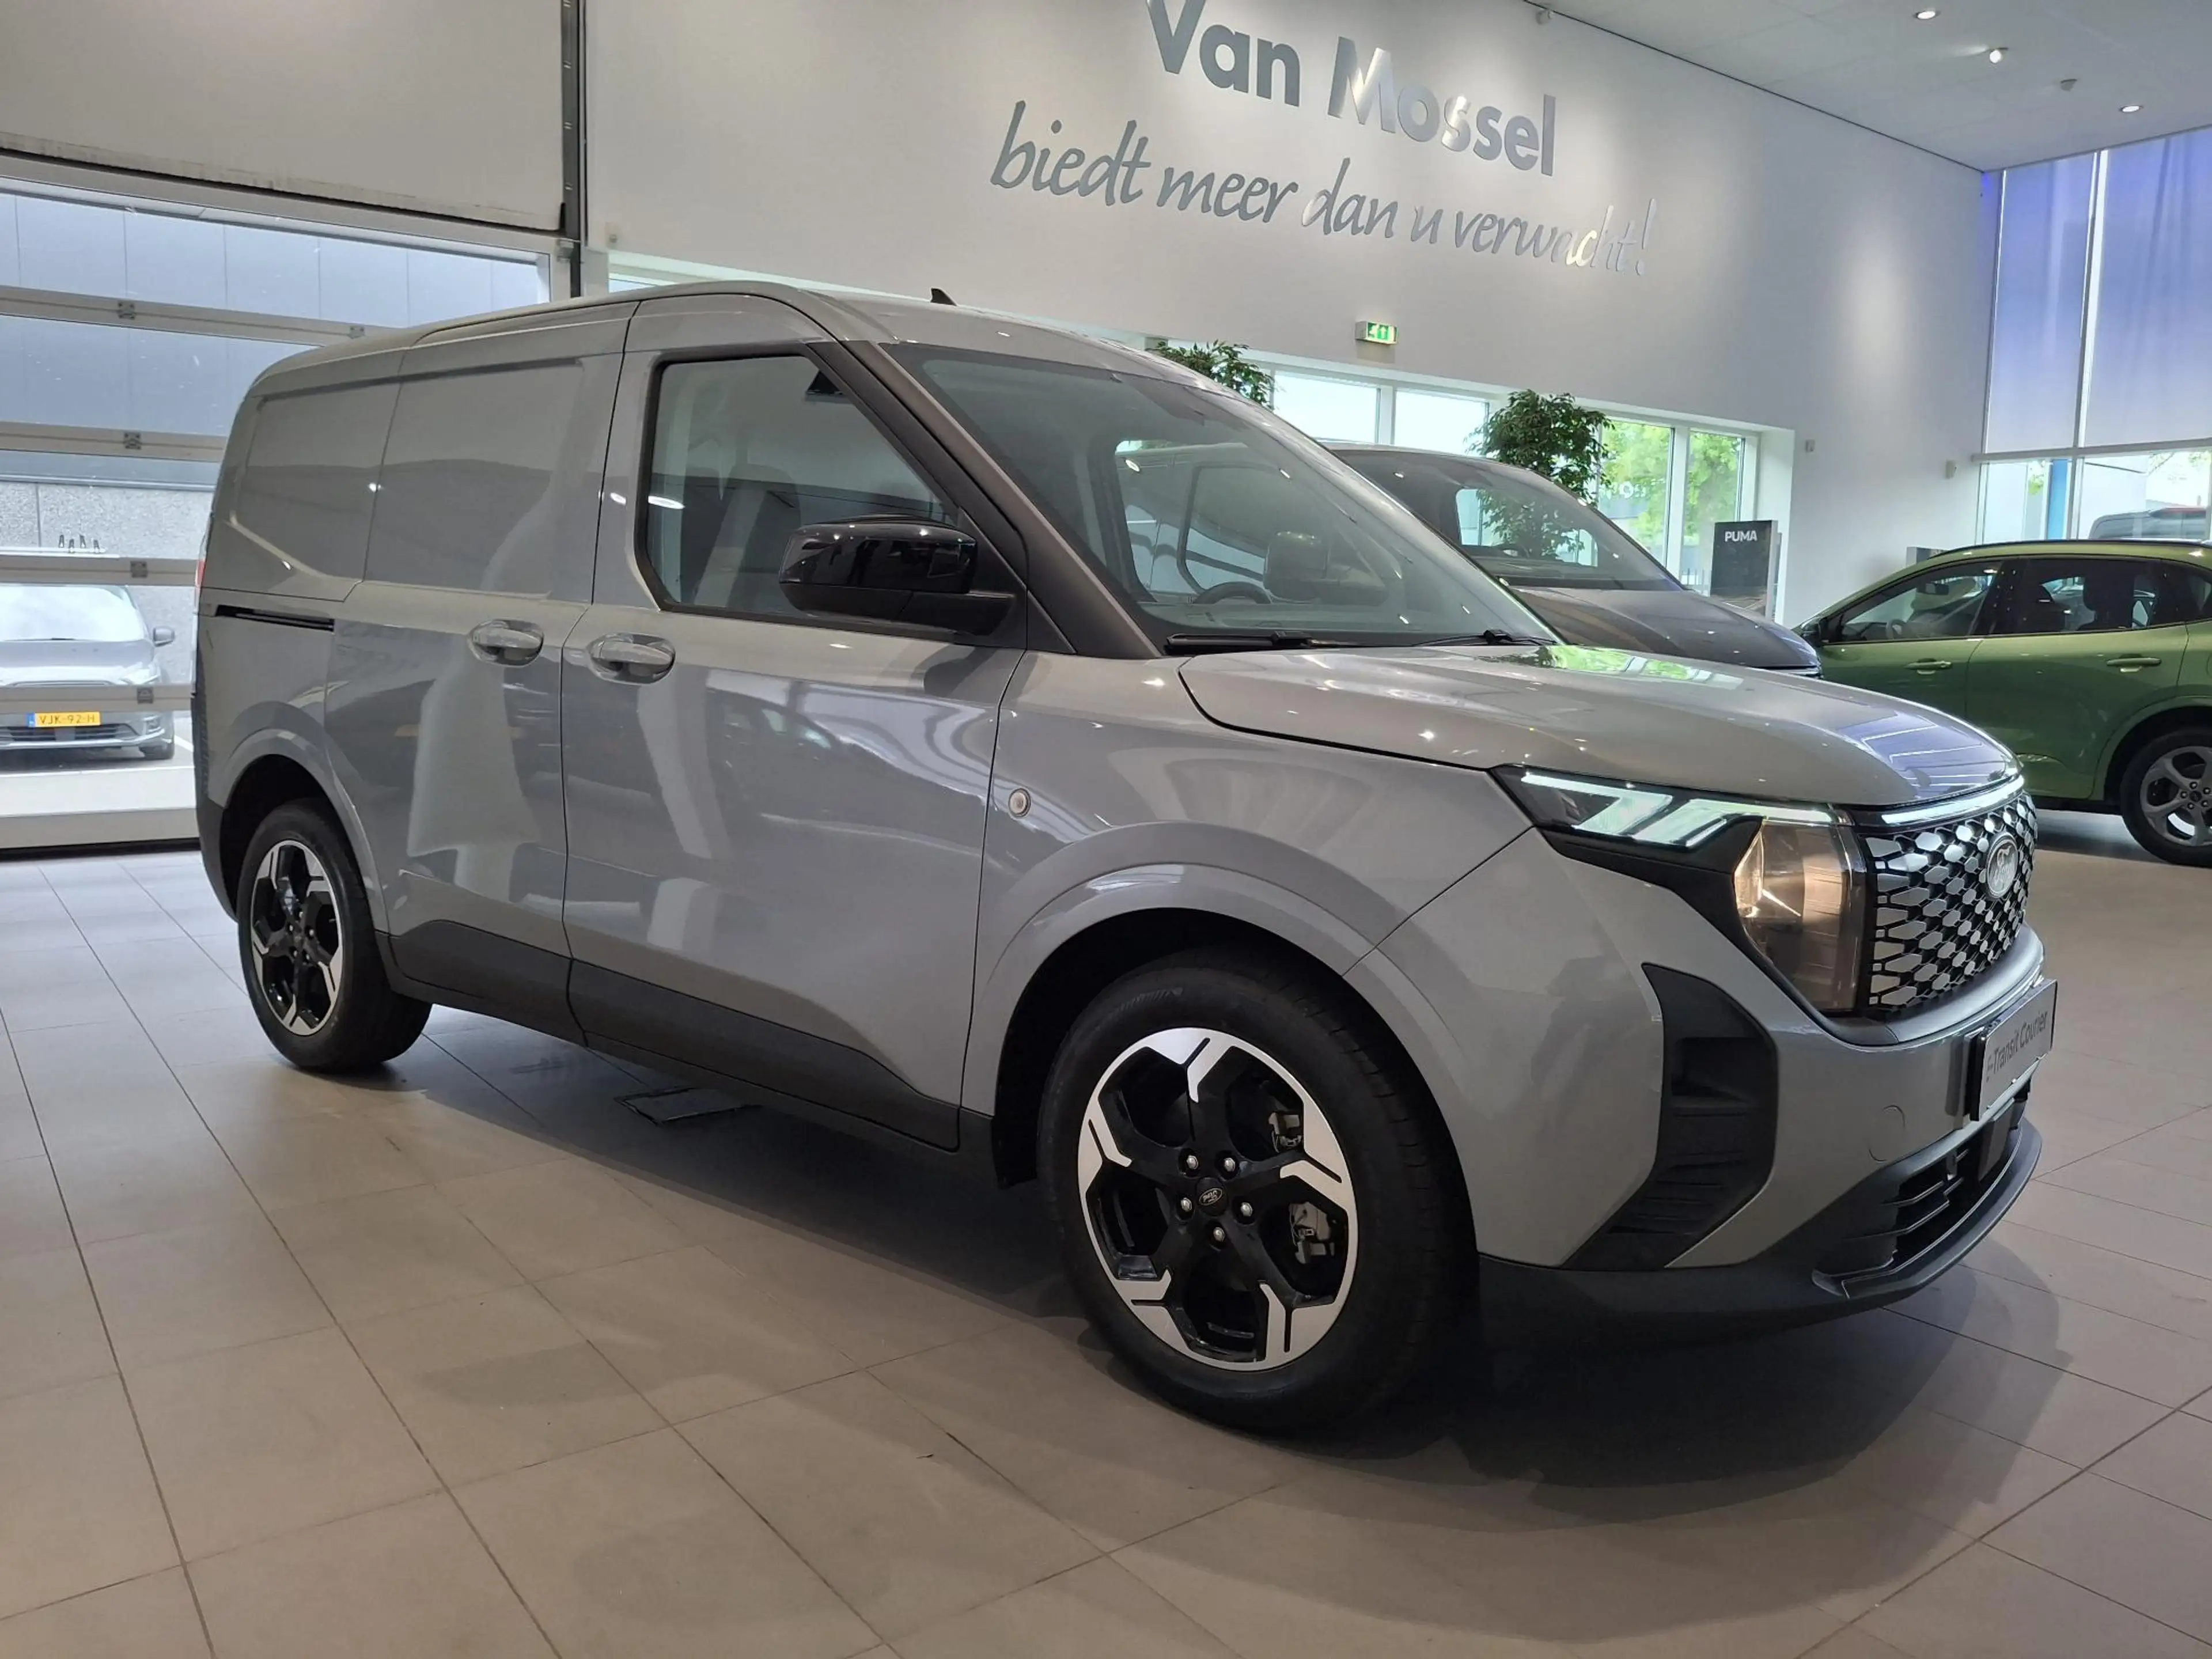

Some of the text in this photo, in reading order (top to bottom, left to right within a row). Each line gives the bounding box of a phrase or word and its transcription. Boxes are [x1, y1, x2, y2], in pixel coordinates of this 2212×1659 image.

[1146, 0, 1556, 176] Van Mossel
[990, 100, 1657, 276] biedt meer dan u verwacht!
[1725, 530, 1758, 542] PUMA
[2020, 1010, 2048, 1048] Courier
